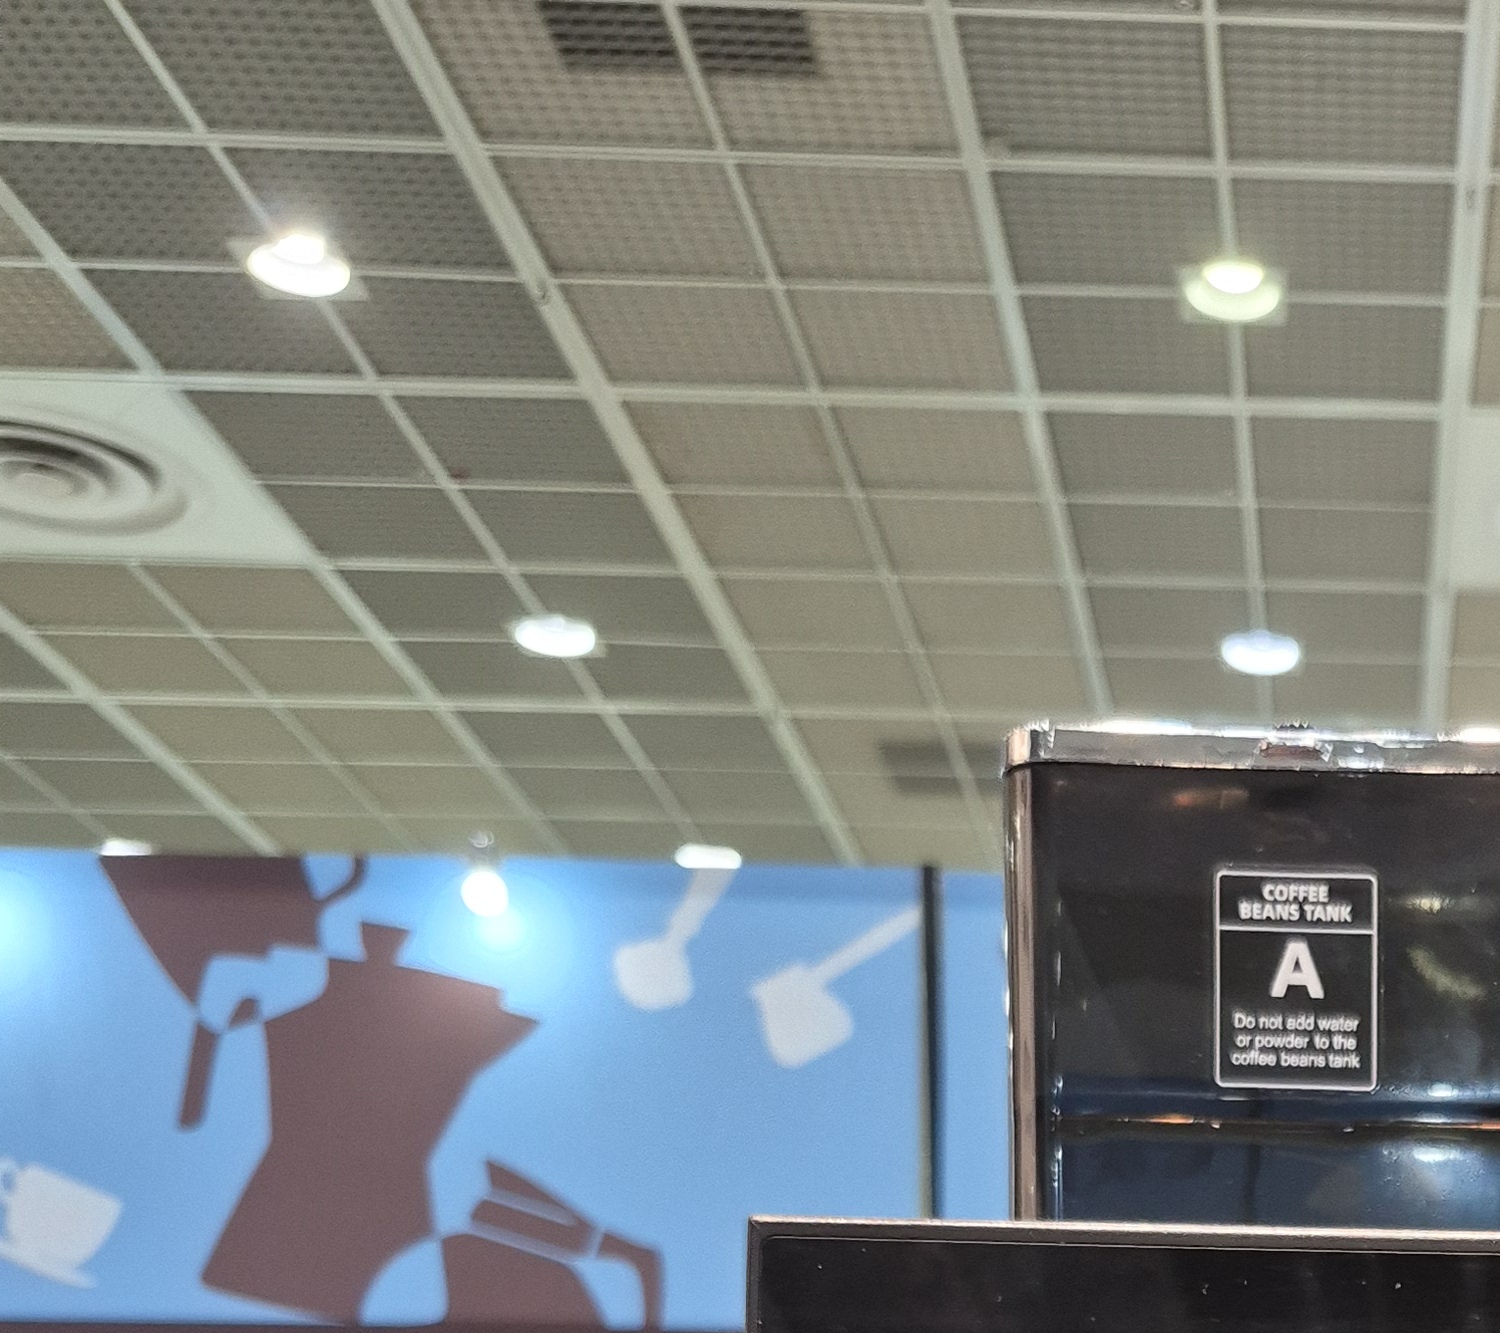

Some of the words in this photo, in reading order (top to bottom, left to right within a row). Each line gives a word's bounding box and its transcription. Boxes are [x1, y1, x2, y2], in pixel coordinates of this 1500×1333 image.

[1262, 883, 1329, 902] COFFEE
[1239, 902, 1300, 921] BEANS
[1303, 904, 1352, 923] TANK
[1270, 939, 1325, 999] A
[1233, 1012, 1256, 1029] Do
[1258, 1013, 1283, 1030] not
[1286, 1013, 1315, 1031] add
[1317, 1016, 1359, 1032] water
[1236, 1034, 1250, 1048] or
[1255, 1032, 1309, 1051] powder
[1314, 1033, 1329, 1049] to
[1332, 1034, 1357, 1050] the
[1231, 1051, 1277, 1067] coffee
[1280, 1052, 1326, 1068] beans
[1328, 1053, 1360, 1069] tank
